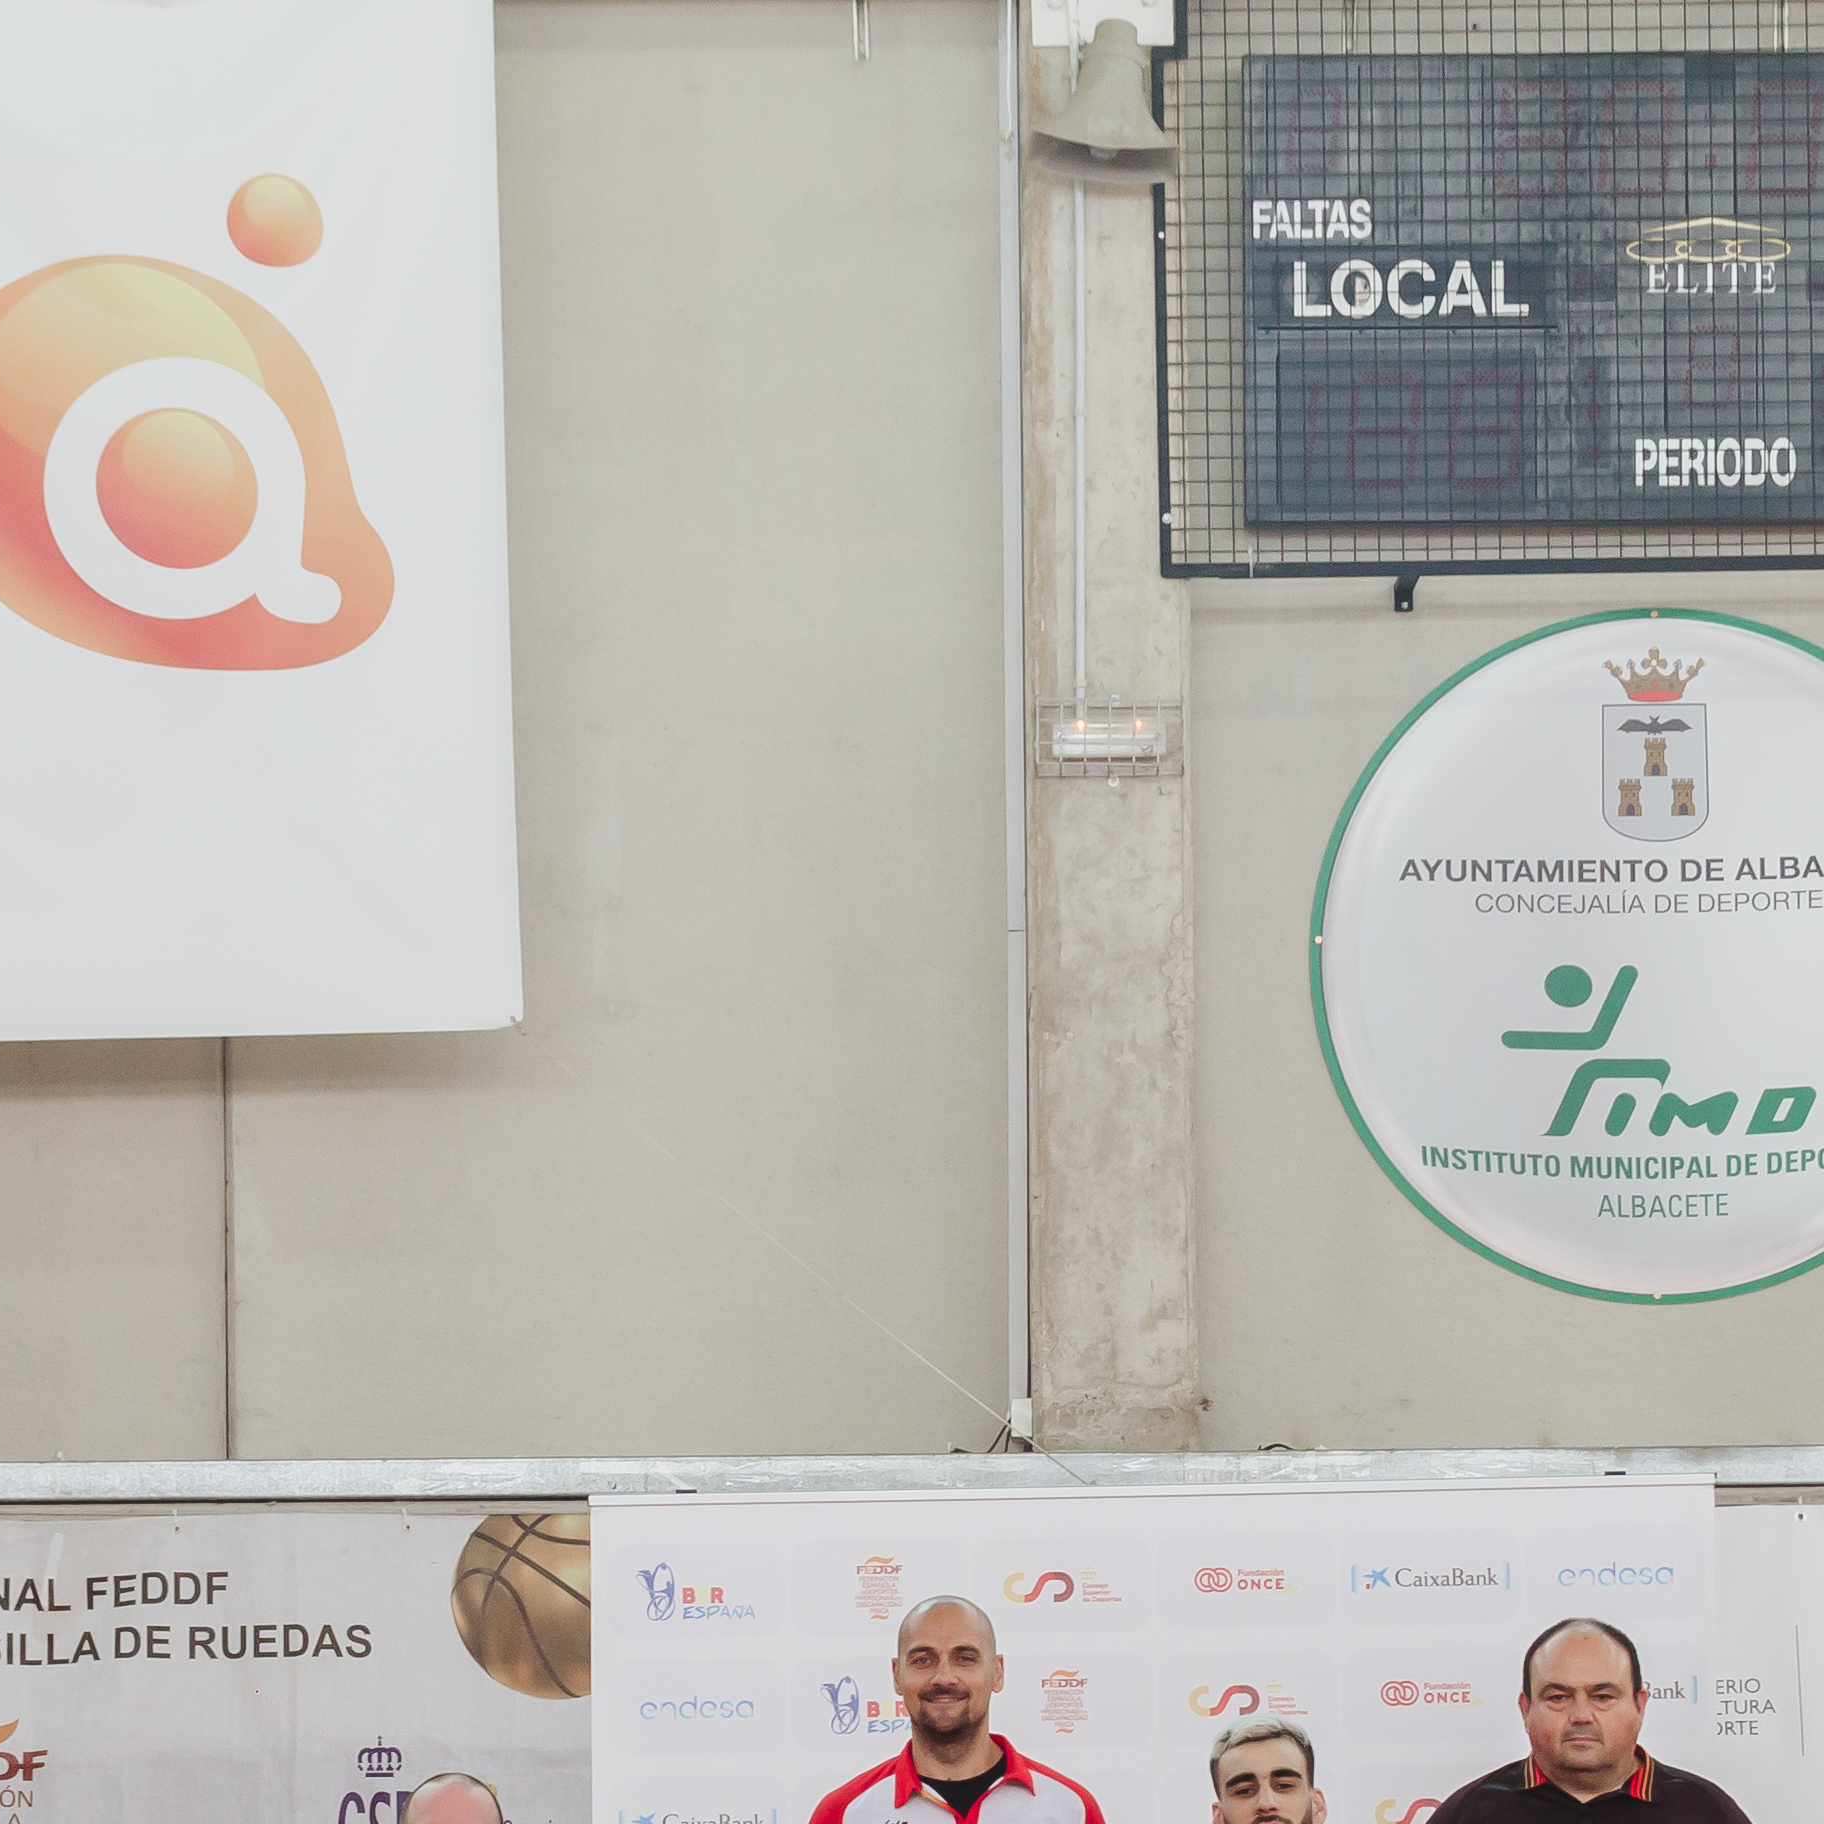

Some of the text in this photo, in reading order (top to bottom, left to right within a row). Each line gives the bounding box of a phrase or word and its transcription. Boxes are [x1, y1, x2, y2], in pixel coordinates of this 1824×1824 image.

[1253, 198, 1373, 241] FALTAS
[1293, 258, 1530, 319] LOCAL
[1646, 262, 1779, 296] ELITE
[1634, 437, 1798, 490] PERIODO
[1399, 858, 1669, 885] AYUNTAMIENTO
[1680, 857, 1726, 883] DE
[1474, 888, 1646, 915] CONCEJALÍA
[1654, 893, 1690, 914] DE
[1420, 1145, 1562, 1178] INSTITUTO
[1570, 1155, 1719, 1180] MUNICIPAL
[1725, 1154, 1759, 1178] DE
[1596, 1192, 1730, 1219] ALBACETE
[1237, 1577, 1285, 1592] ONCE
[1394, 1566, 1499, 1588] CaixaBank
[1557, 1561, 1674, 1587] endesa
[85, 1570, 229, 1611] FEDDF
[682, 1604, 756, 1620] ESPAÑA
[112, 1625, 172, 1660] DE
[187, 1623, 373, 1661] RUEDAS
[639, 1694, 755, 1721] endesa
[1422, 1691, 1471, 1704] ONCE
